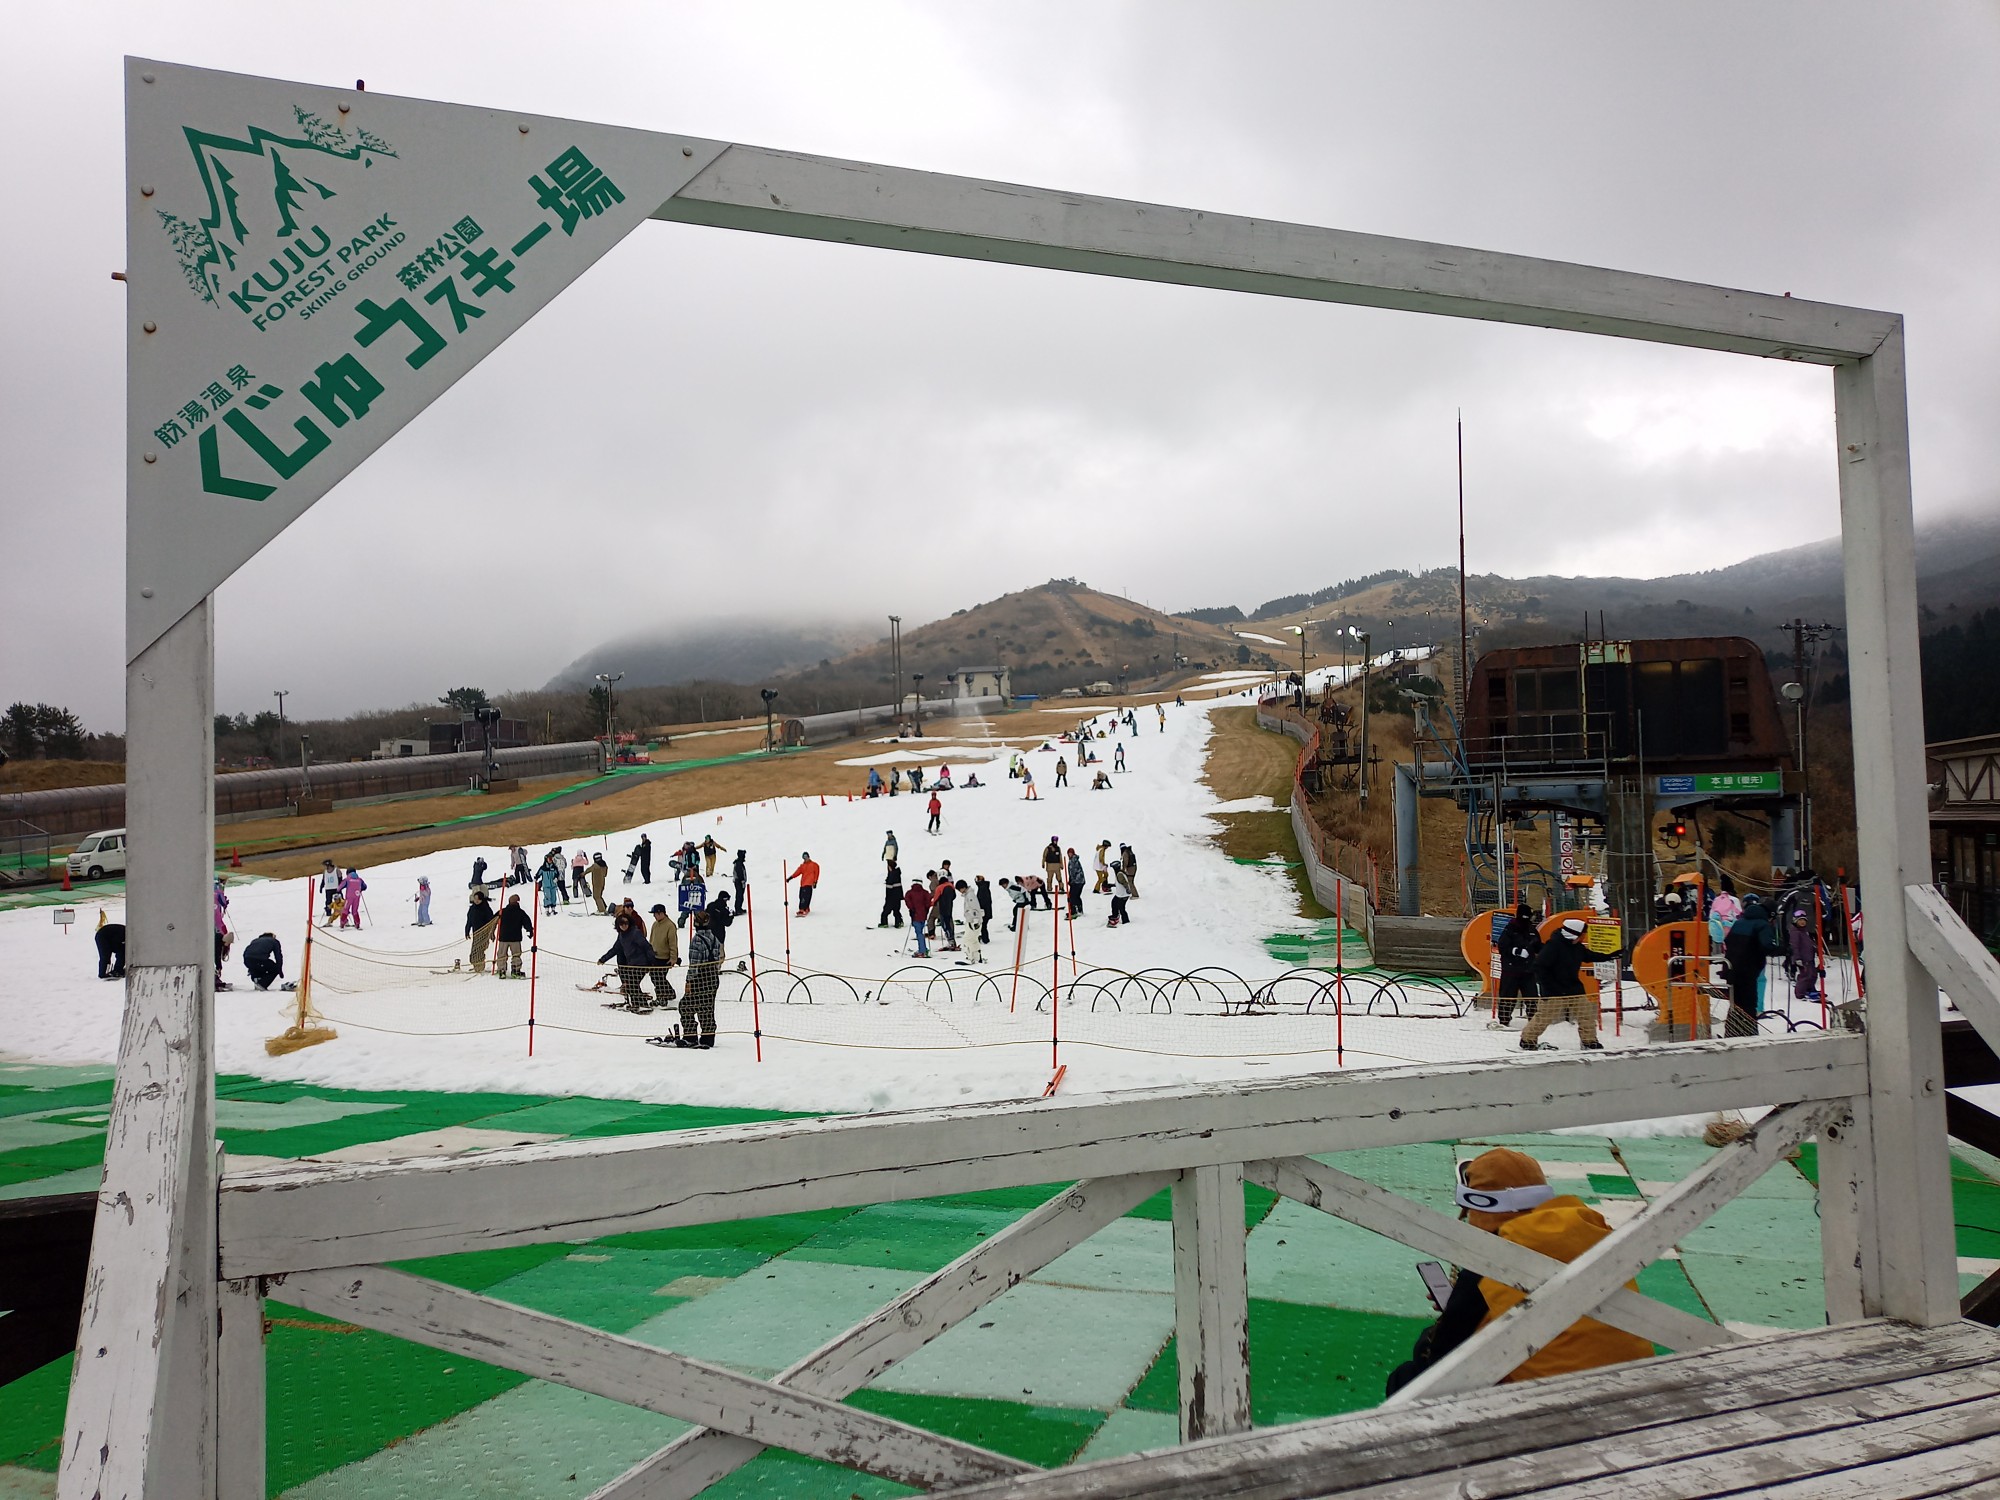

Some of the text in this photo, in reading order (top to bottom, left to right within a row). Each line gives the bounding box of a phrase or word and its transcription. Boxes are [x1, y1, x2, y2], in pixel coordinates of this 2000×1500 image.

[228, 225, 331, 314] KUJU
[252, 212, 397, 332] FOREST PARK
[300, 232, 406, 320] SKIING GROUND
[396, 215, 484, 292] 森林公園
[154, 364, 256, 449] 筋湯温泉
